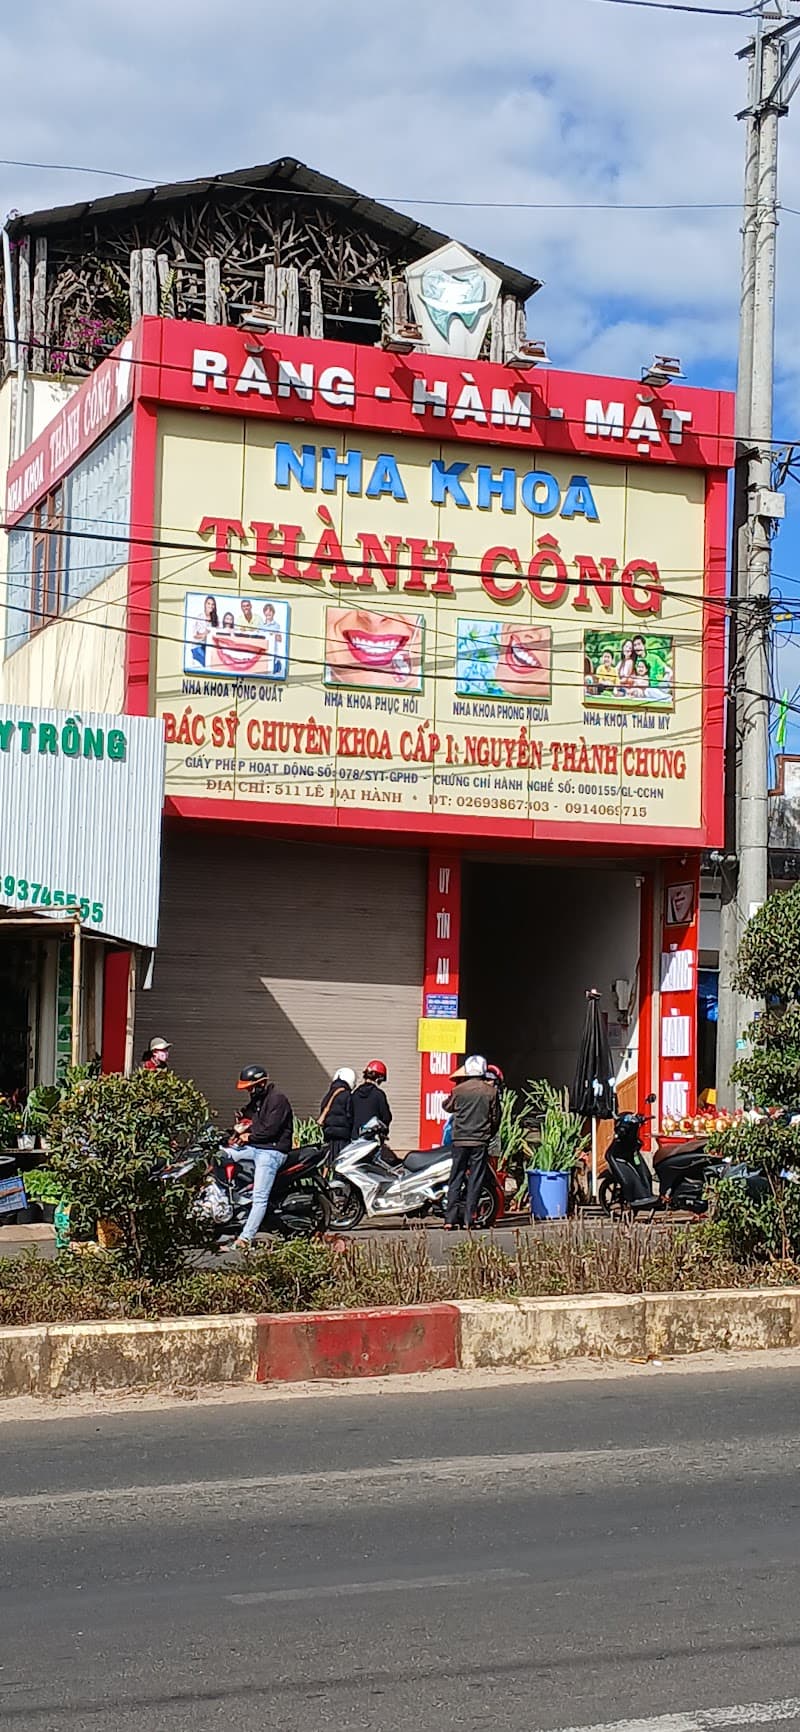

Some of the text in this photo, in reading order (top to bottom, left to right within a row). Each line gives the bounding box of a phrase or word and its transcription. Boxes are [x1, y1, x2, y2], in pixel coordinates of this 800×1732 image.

[192, 344, 356, 406] RĂNG
[412, 372, 531, 427] HÀM
[585, 394, 692, 453] MẶT
[274, 441, 600, 522] NHA KHOA
[198, 504, 664, 612] THÀNH CÔNG
[182, 679, 202, 695] NHA
[203, 681, 229, 697] KHOA
[324, 692, 343, 708] NHA
[347, 694, 372, 710] KHOA
[375, 696, 400, 715] PHỤC
[453, 702, 471, 716] NHA
[472, 703, 496, 718] KHOA
[583, 711, 601, 727] NHA
[604, 712, 628, 728] KHOA
[163, 705, 206, 746] BÁC
[247, 716, 332, 756] CHUYÊN
[336, 726, 393, 760] KHOA
[399, 719, 441, 763] CẤP
[550, 736, 619, 775] THÀNH
[623, 746, 686, 779] CHUNG
[249, 760, 279, 776] HOẠT
[283, 762, 314, 778] ĐỘNG
[494, 776, 523, 791] HÀNH
[206, 779, 233, 793] ĐỊA
[274, 784, 301, 796] 511
[305, 784, 325, 798] LÊ
[330, 787, 356, 802] ĐẠI
[361, 787, 403, 803] HÀNH
[439, 867, 451, 894] UY
[0, 875, 103, 923] 93745555
[437, 907, 450, 939] TÍN
[436, 957, 449, 985] AN
